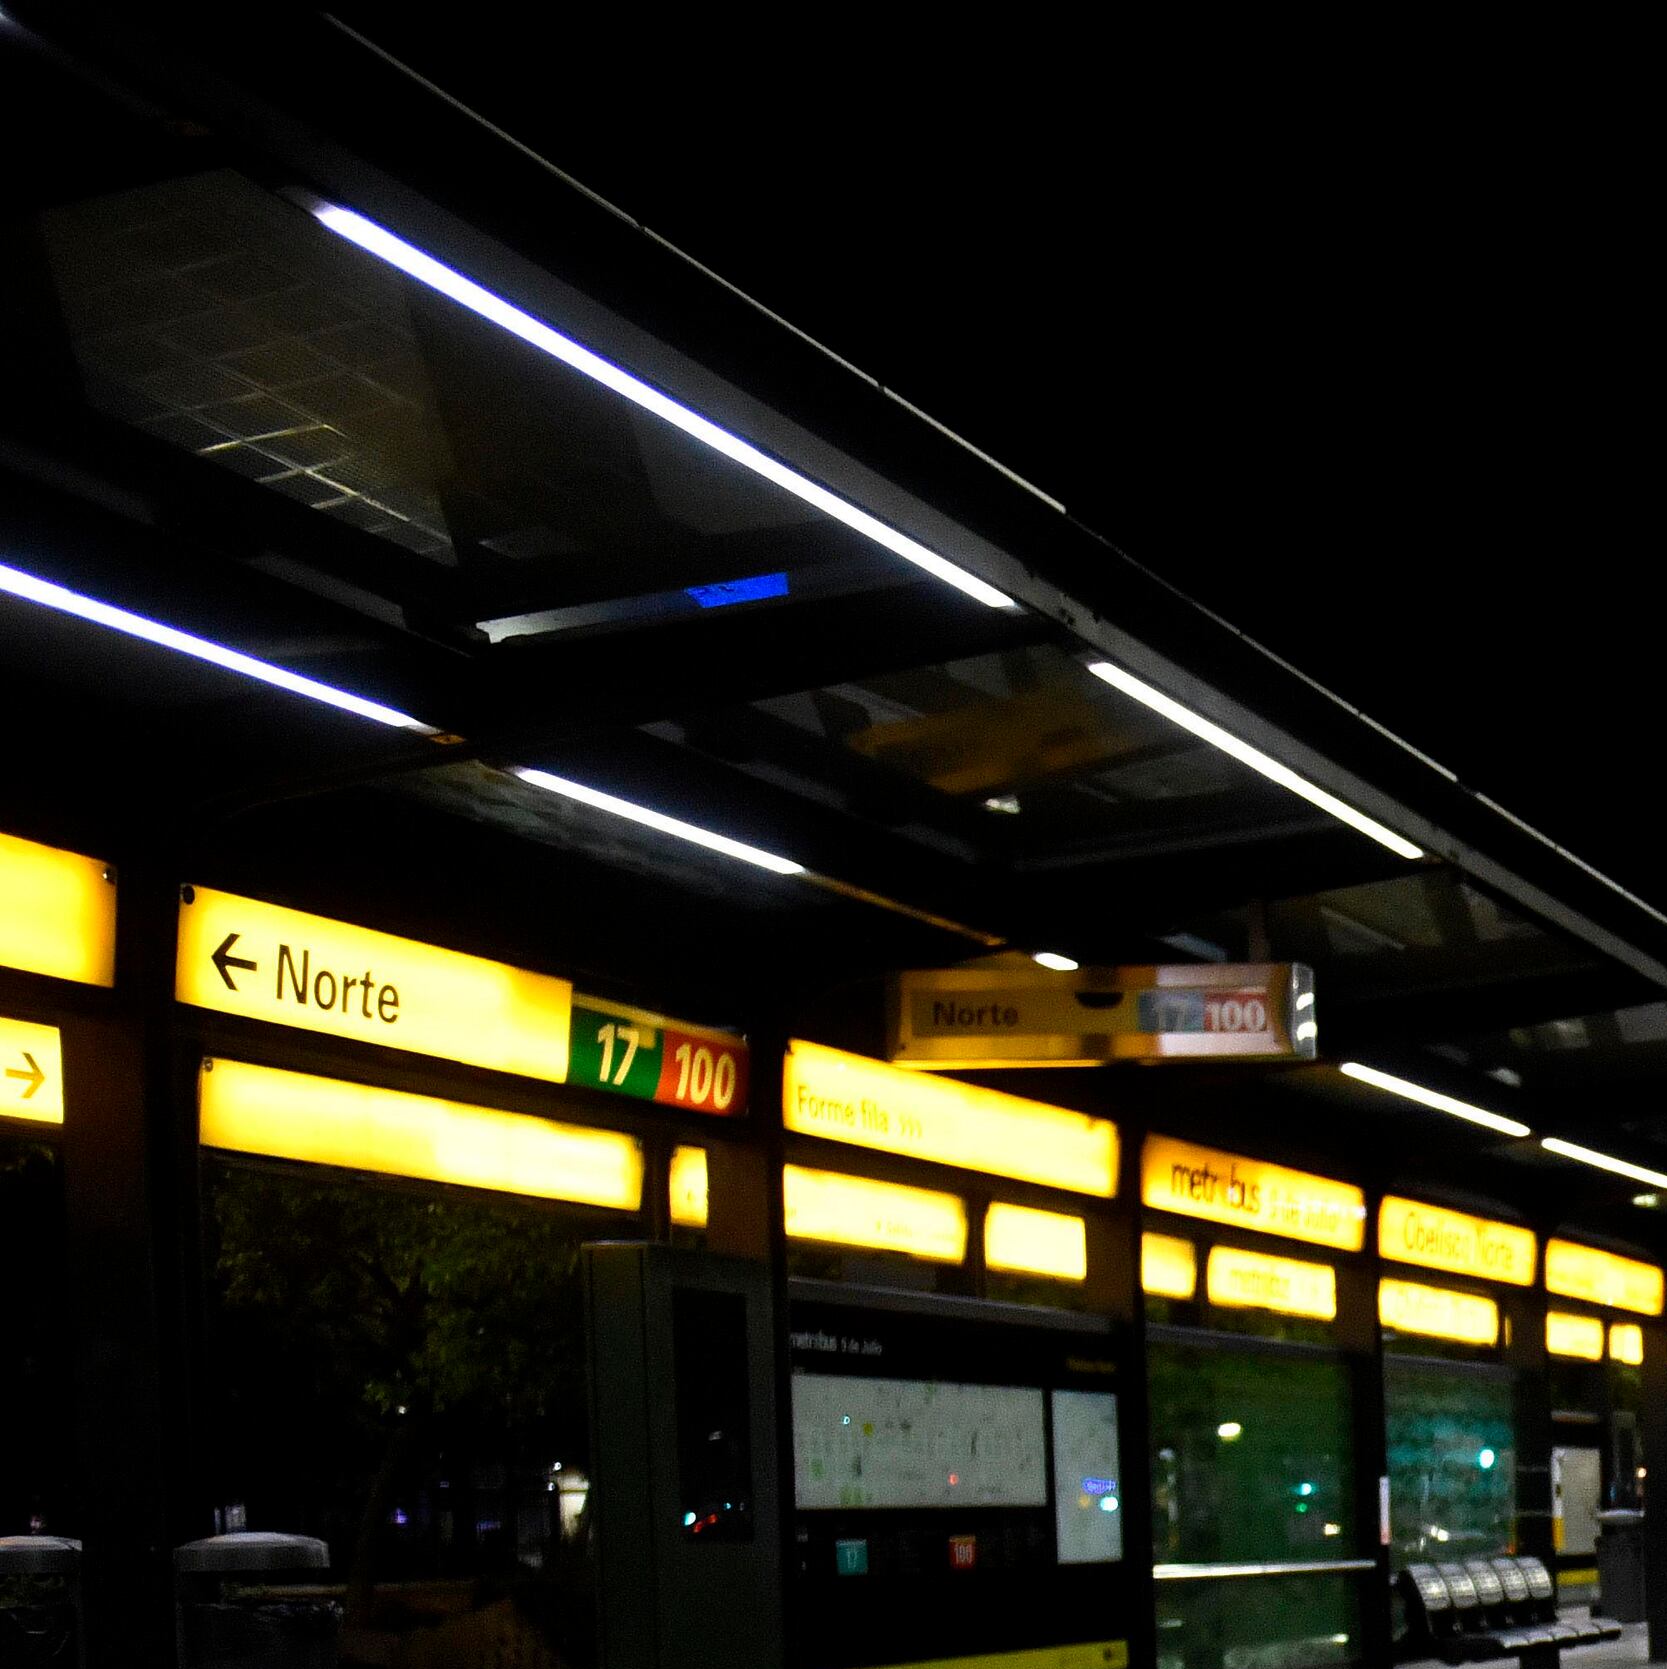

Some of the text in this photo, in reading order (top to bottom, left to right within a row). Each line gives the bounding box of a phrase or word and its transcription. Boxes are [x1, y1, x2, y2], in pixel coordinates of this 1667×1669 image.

[276, 944, 736, 1110] Norte 17 100
[932, 1001, 1019, 1027] Norte
[1207, 1000, 1265, 1032] 100
[797, 1084, 890, 1136] Forme fila
[1171, 1161, 1261, 1214] metrbus
